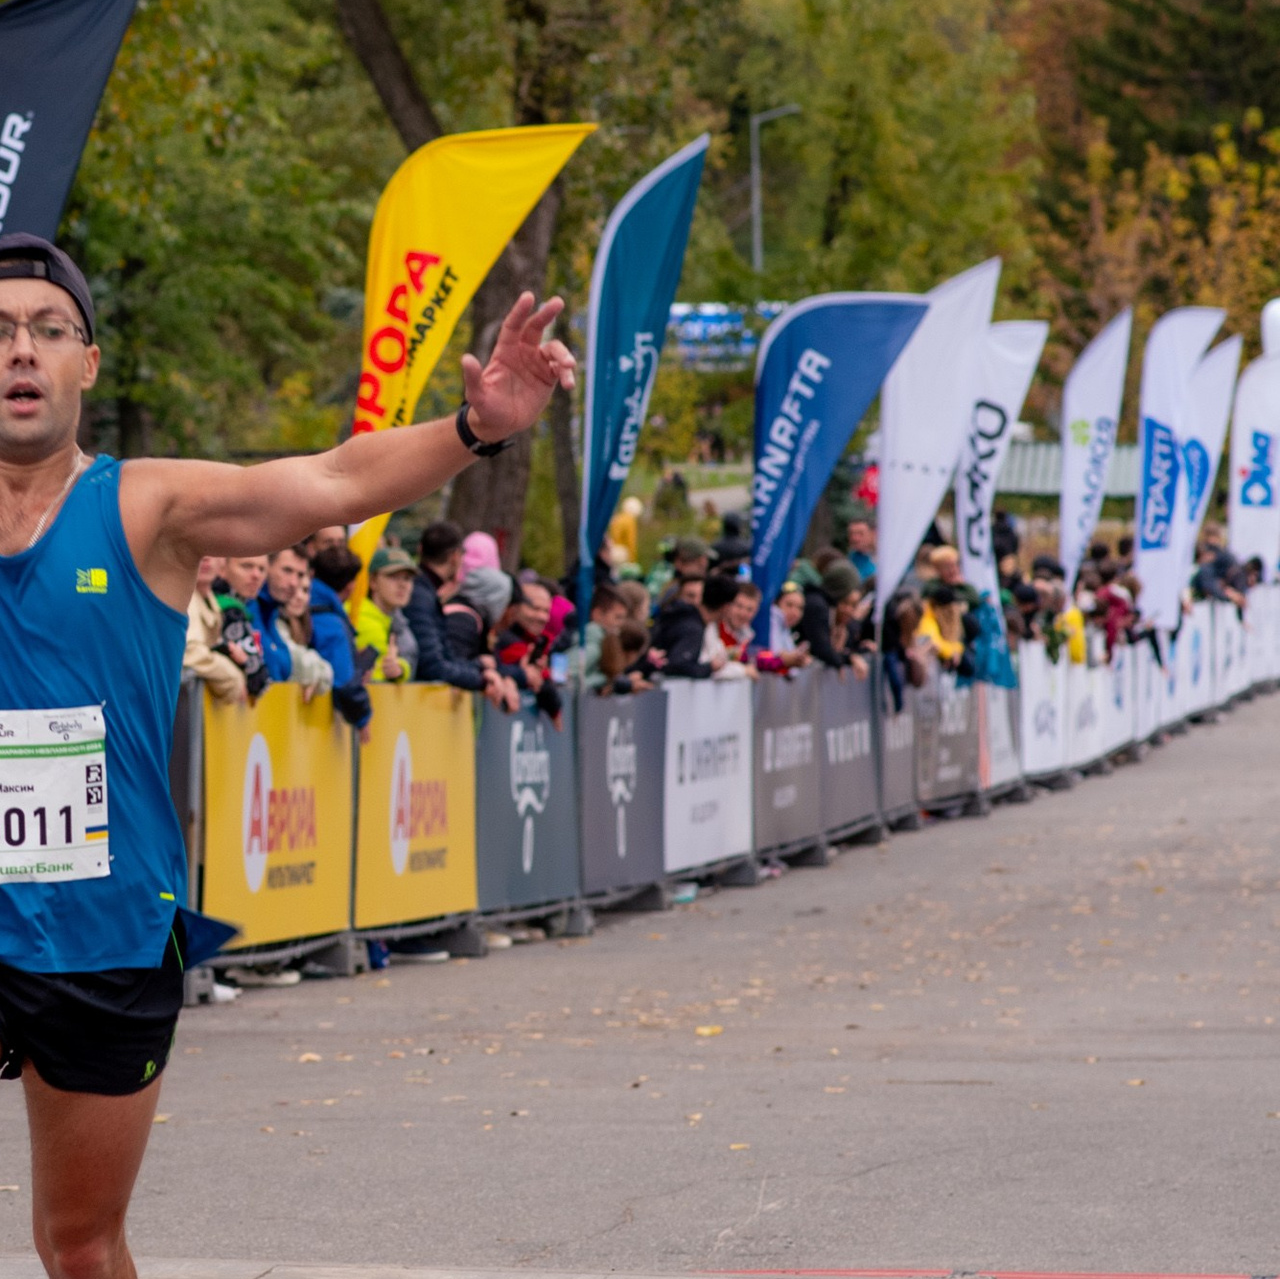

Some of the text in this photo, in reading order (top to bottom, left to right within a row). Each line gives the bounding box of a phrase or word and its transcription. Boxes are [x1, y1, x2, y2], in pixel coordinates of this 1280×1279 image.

[353, 251, 442, 434] РОРА
[751, 347, 832, 529] KRNAFTA
[246, 761, 317, 854] АВРОРА
